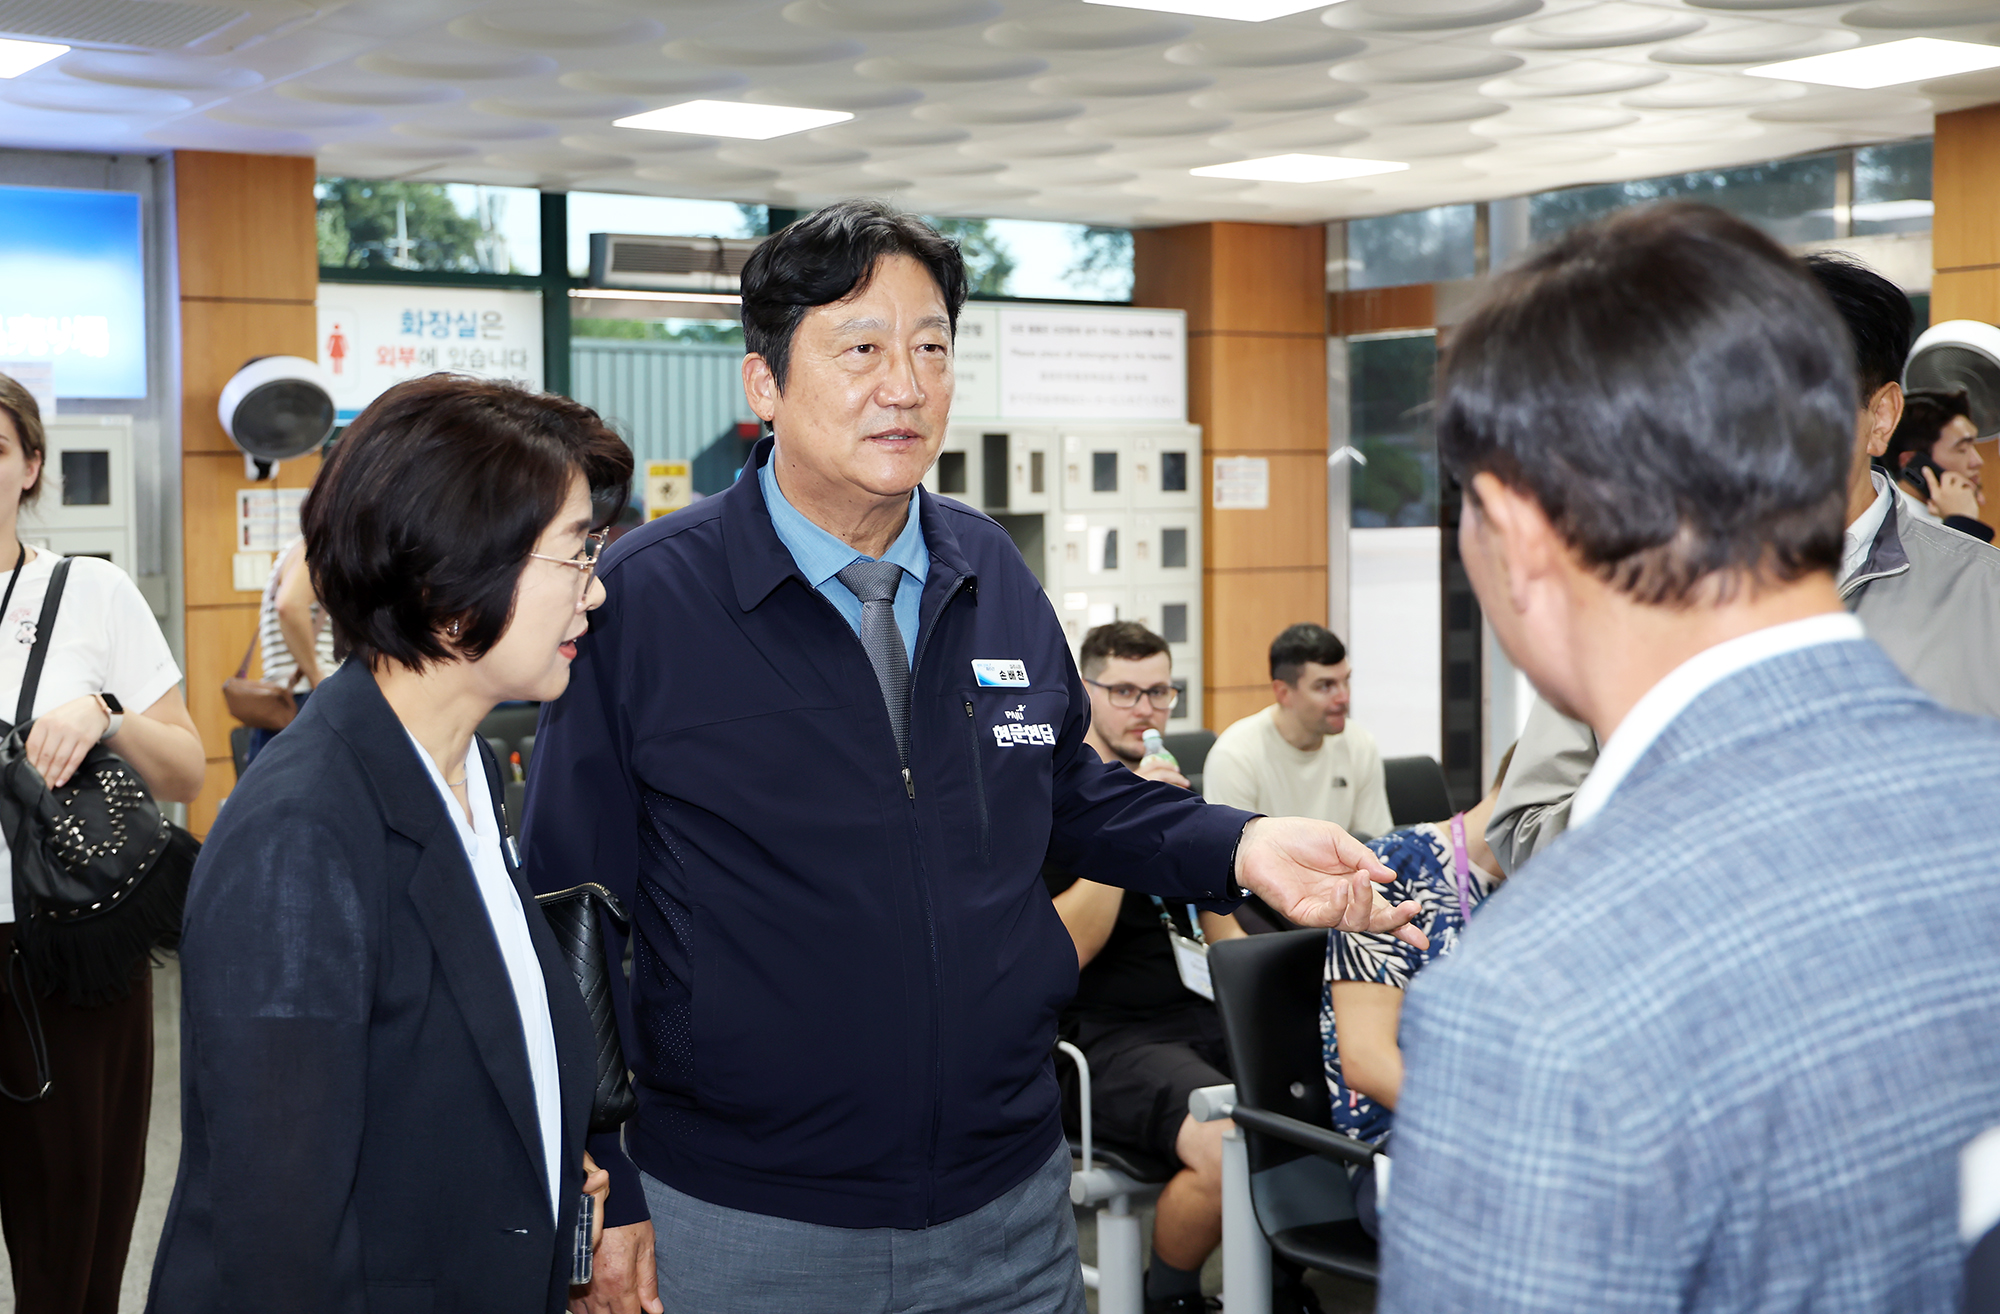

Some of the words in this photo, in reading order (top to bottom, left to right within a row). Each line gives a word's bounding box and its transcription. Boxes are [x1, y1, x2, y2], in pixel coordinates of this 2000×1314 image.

[401, 308, 505, 341] 화장실은
[376, 346, 437, 368] 외부에
[448, 346, 528, 370] 있습니다
[992, 723, 1057, 748] 현문현답
